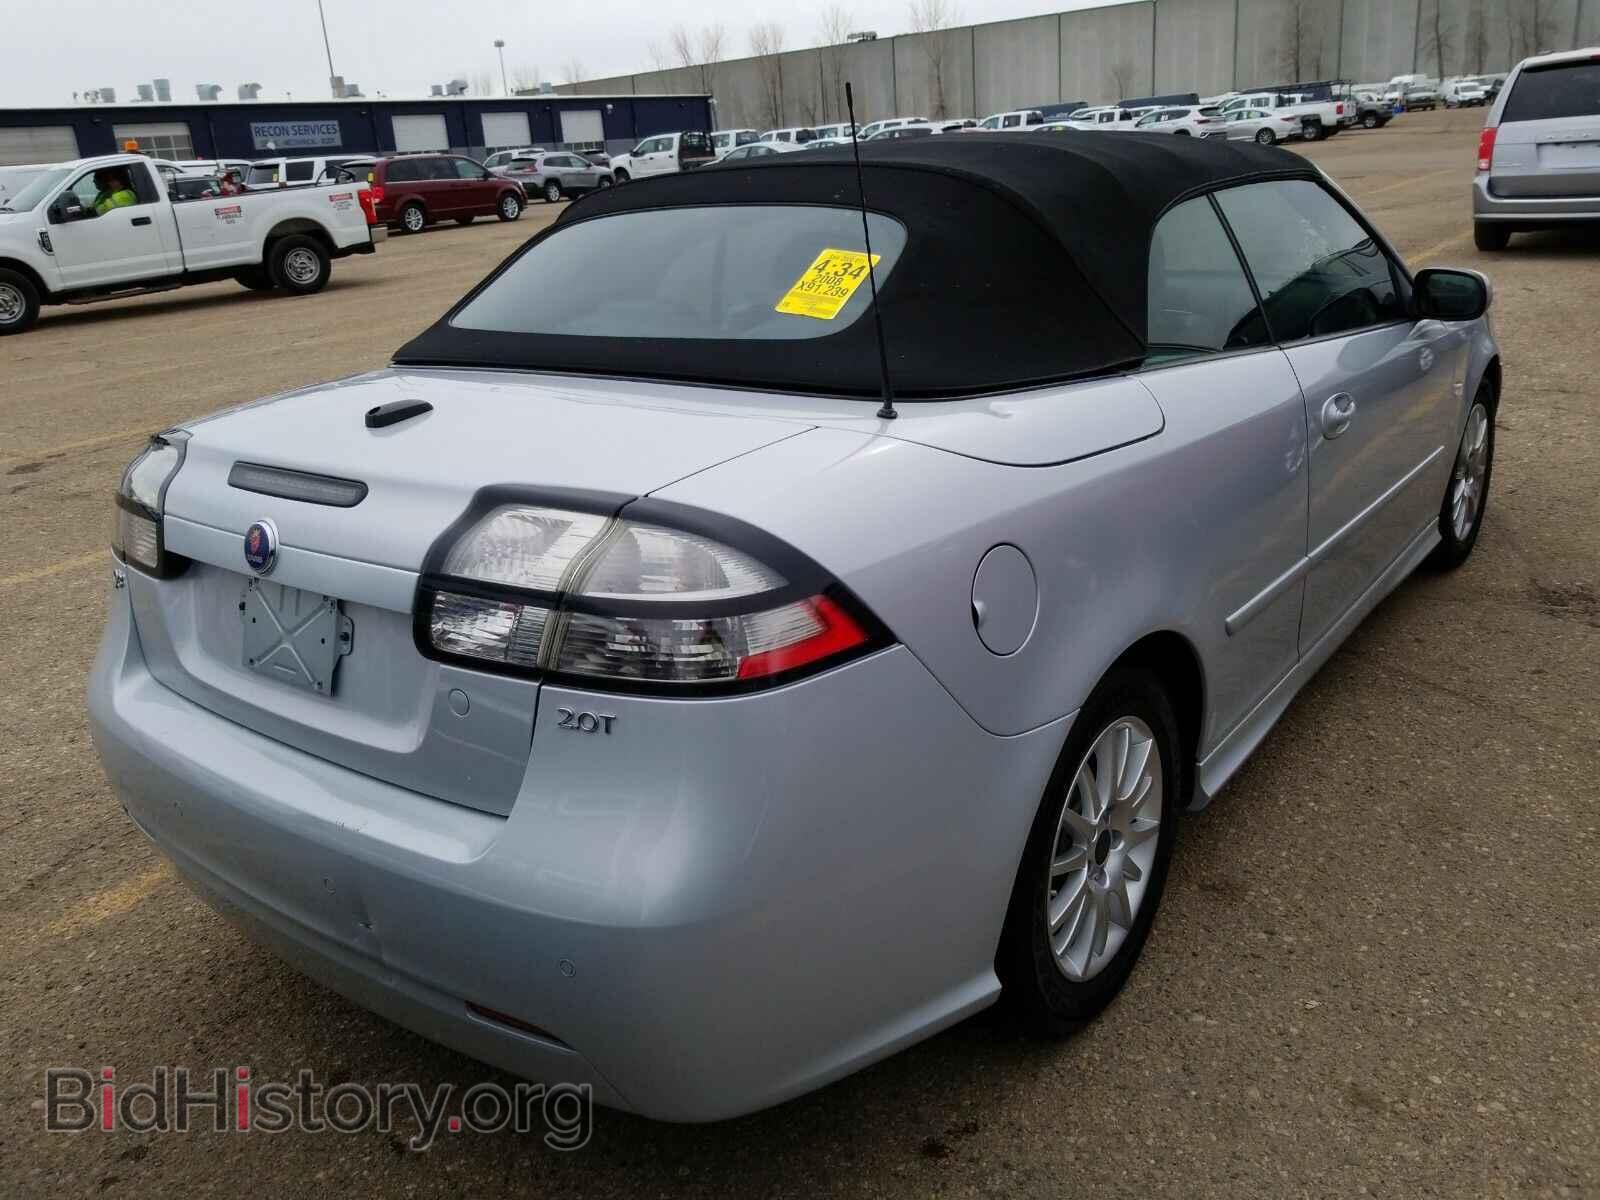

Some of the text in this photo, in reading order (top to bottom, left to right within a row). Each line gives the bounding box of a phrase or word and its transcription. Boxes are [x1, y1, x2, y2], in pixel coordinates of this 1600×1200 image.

[255, 123, 338, 137] RECON SERVICES
[811, 273, 844, 286] 2008
